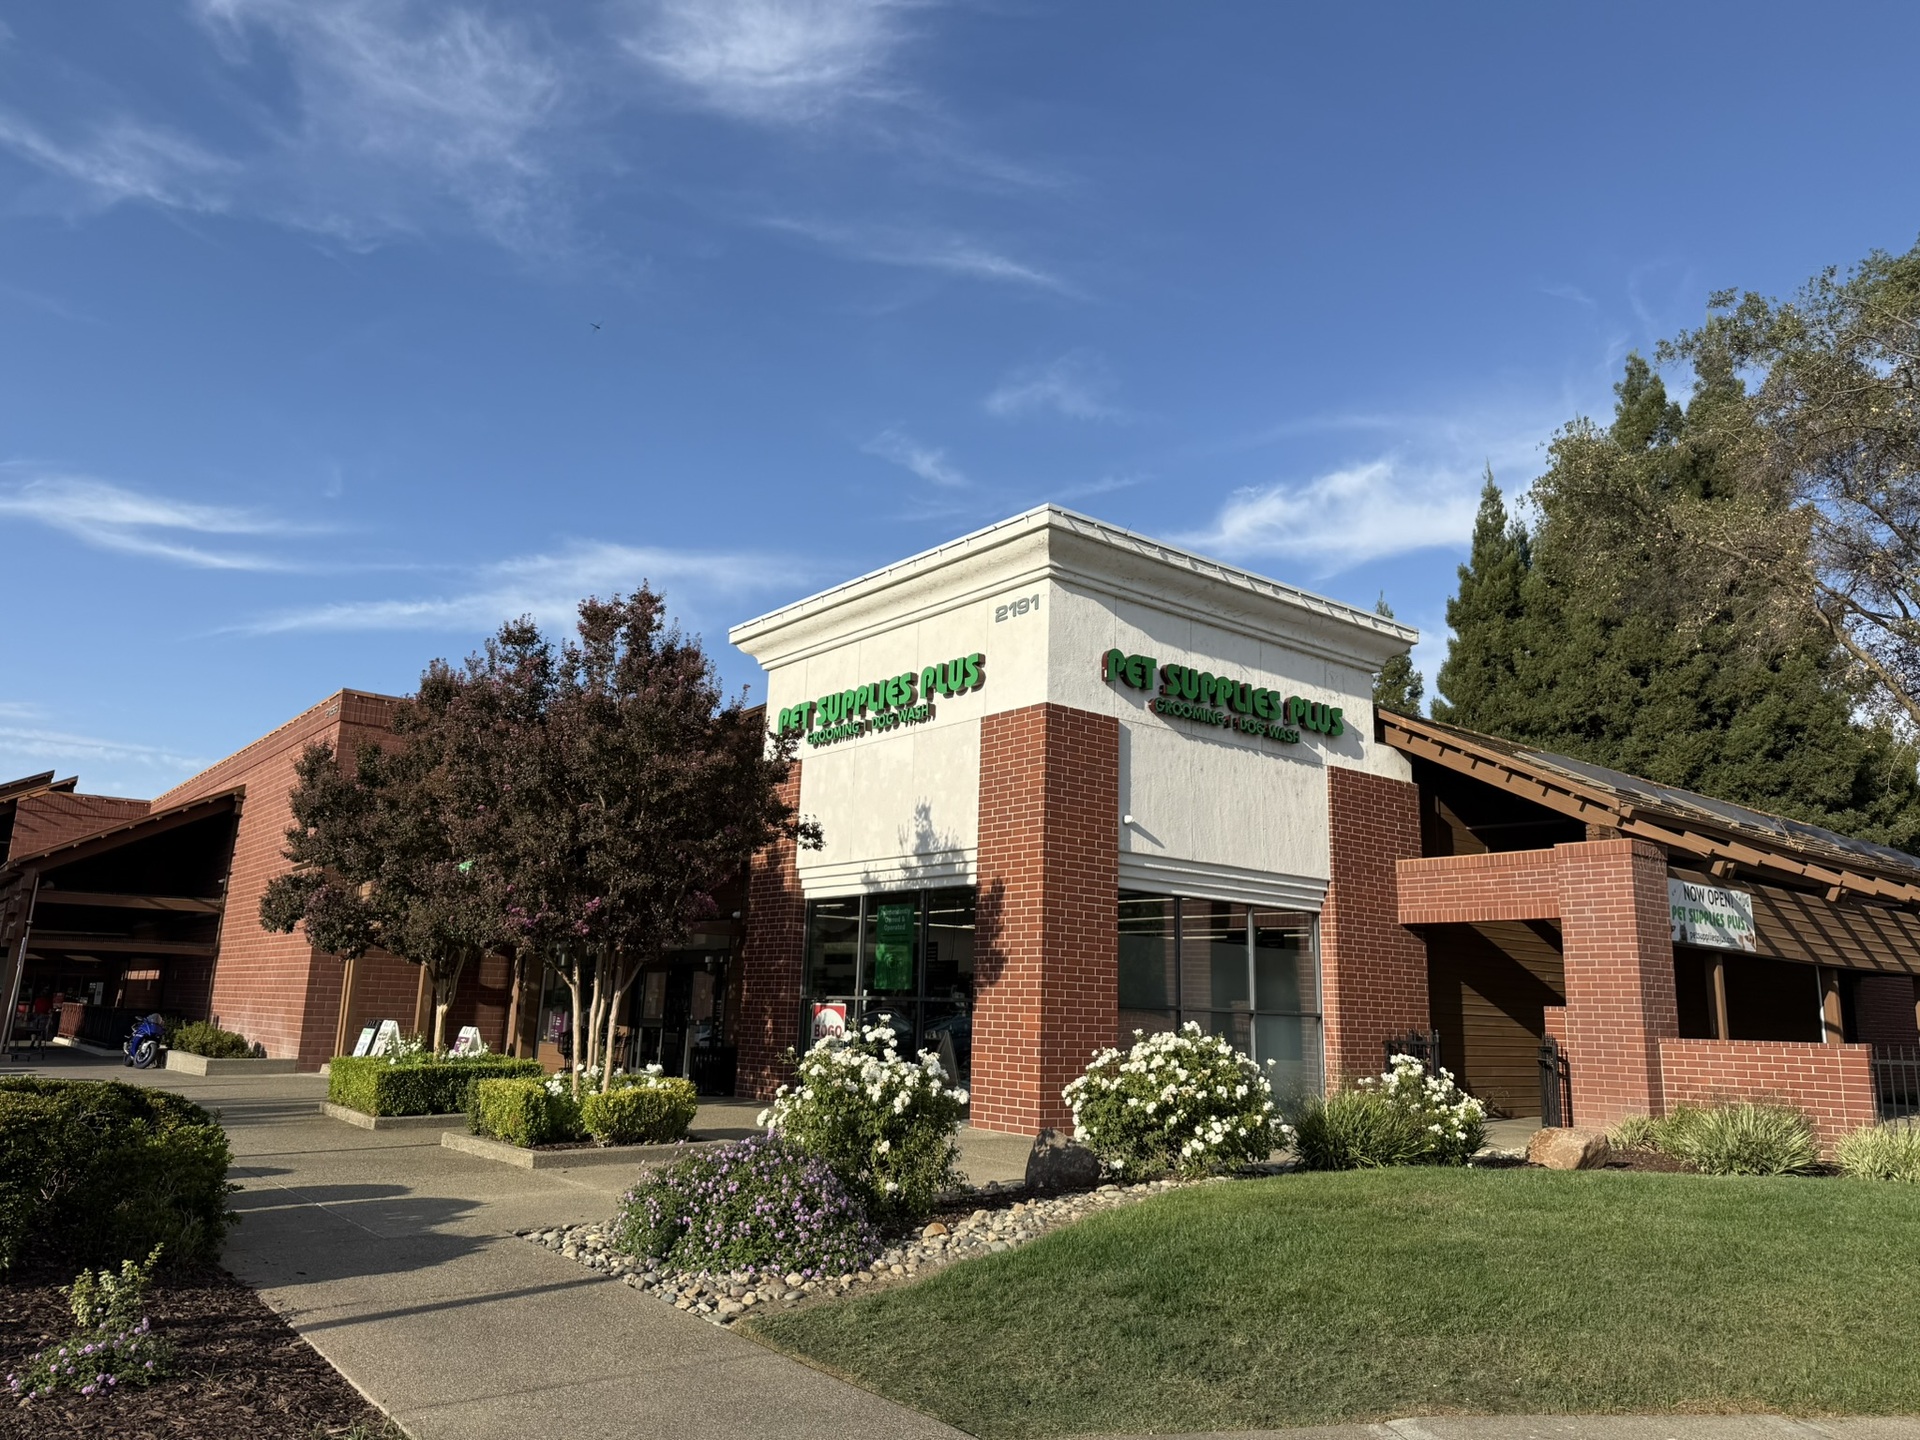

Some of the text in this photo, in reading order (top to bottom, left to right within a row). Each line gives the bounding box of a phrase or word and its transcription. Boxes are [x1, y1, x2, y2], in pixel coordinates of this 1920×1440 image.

[995, 594, 1039, 623] 2191
[778, 653, 983, 735] PET SUPPLIES PLUS
[1104, 648, 1344, 736] PET SUPPLIES PLUS
[806, 722, 860, 745] GROOMING
[872, 712, 895, 729] DOG
[898, 703, 930, 723] WASH
[1154, 699, 1225, 726] GROOMING
[1239, 716, 1265, 736] DOG
[1268, 723, 1300, 744] WASH
[1683, 884, 1734, 908] NOW OPEN!
[1671, 905, 1746, 931] PET SUPPLIES PLUS
[814, 1024, 843, 1039] BOGO
